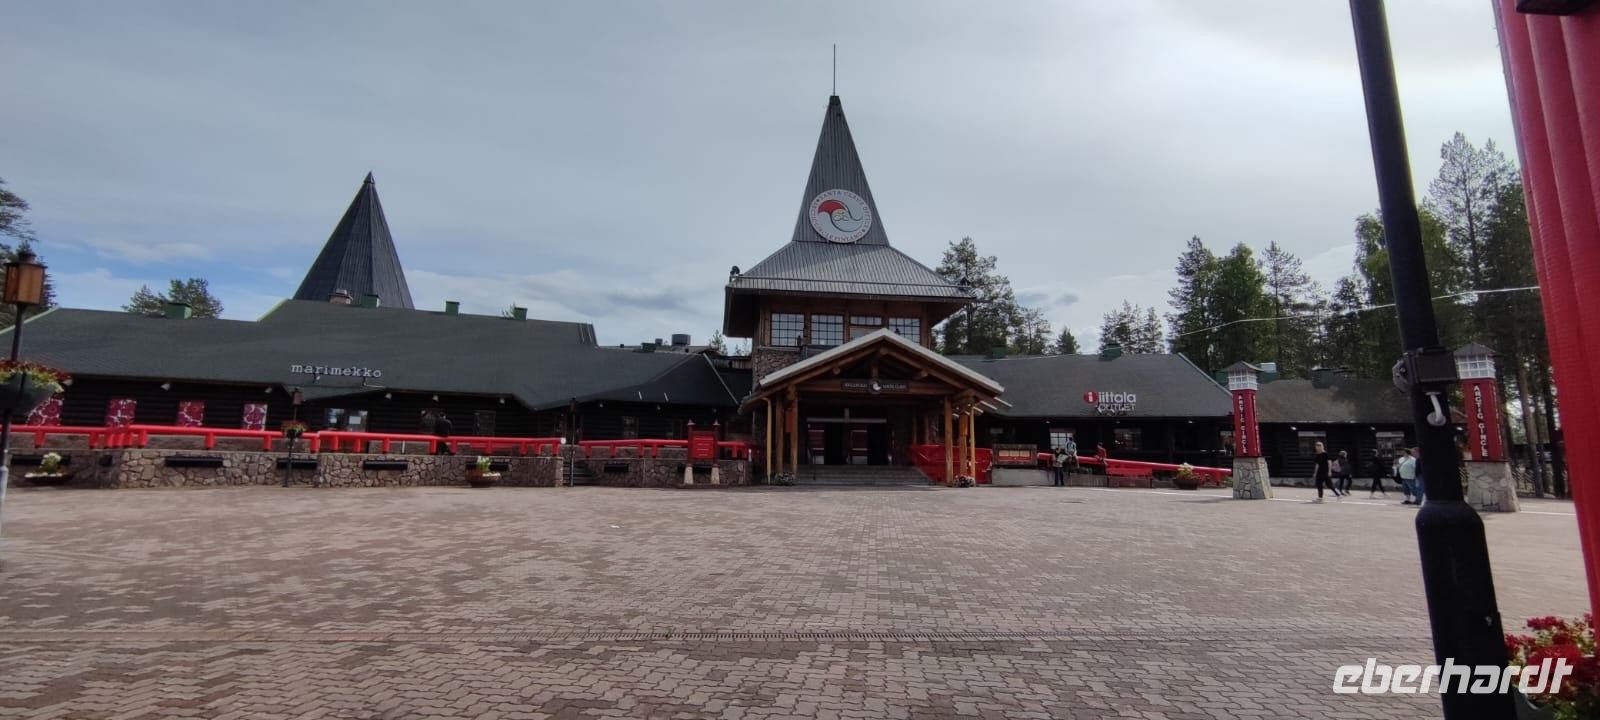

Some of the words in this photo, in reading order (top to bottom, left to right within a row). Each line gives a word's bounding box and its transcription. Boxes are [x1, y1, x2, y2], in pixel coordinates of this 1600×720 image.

[291, 364, 382, 378] marimekko
[1098, 391, 1137, 403] iittala
[1473, 385, 1484, 420] ARCTIC
[1098, 404, 1136, 412] OUTLET
[1478, 422, 1488, 457] CIRCLE
